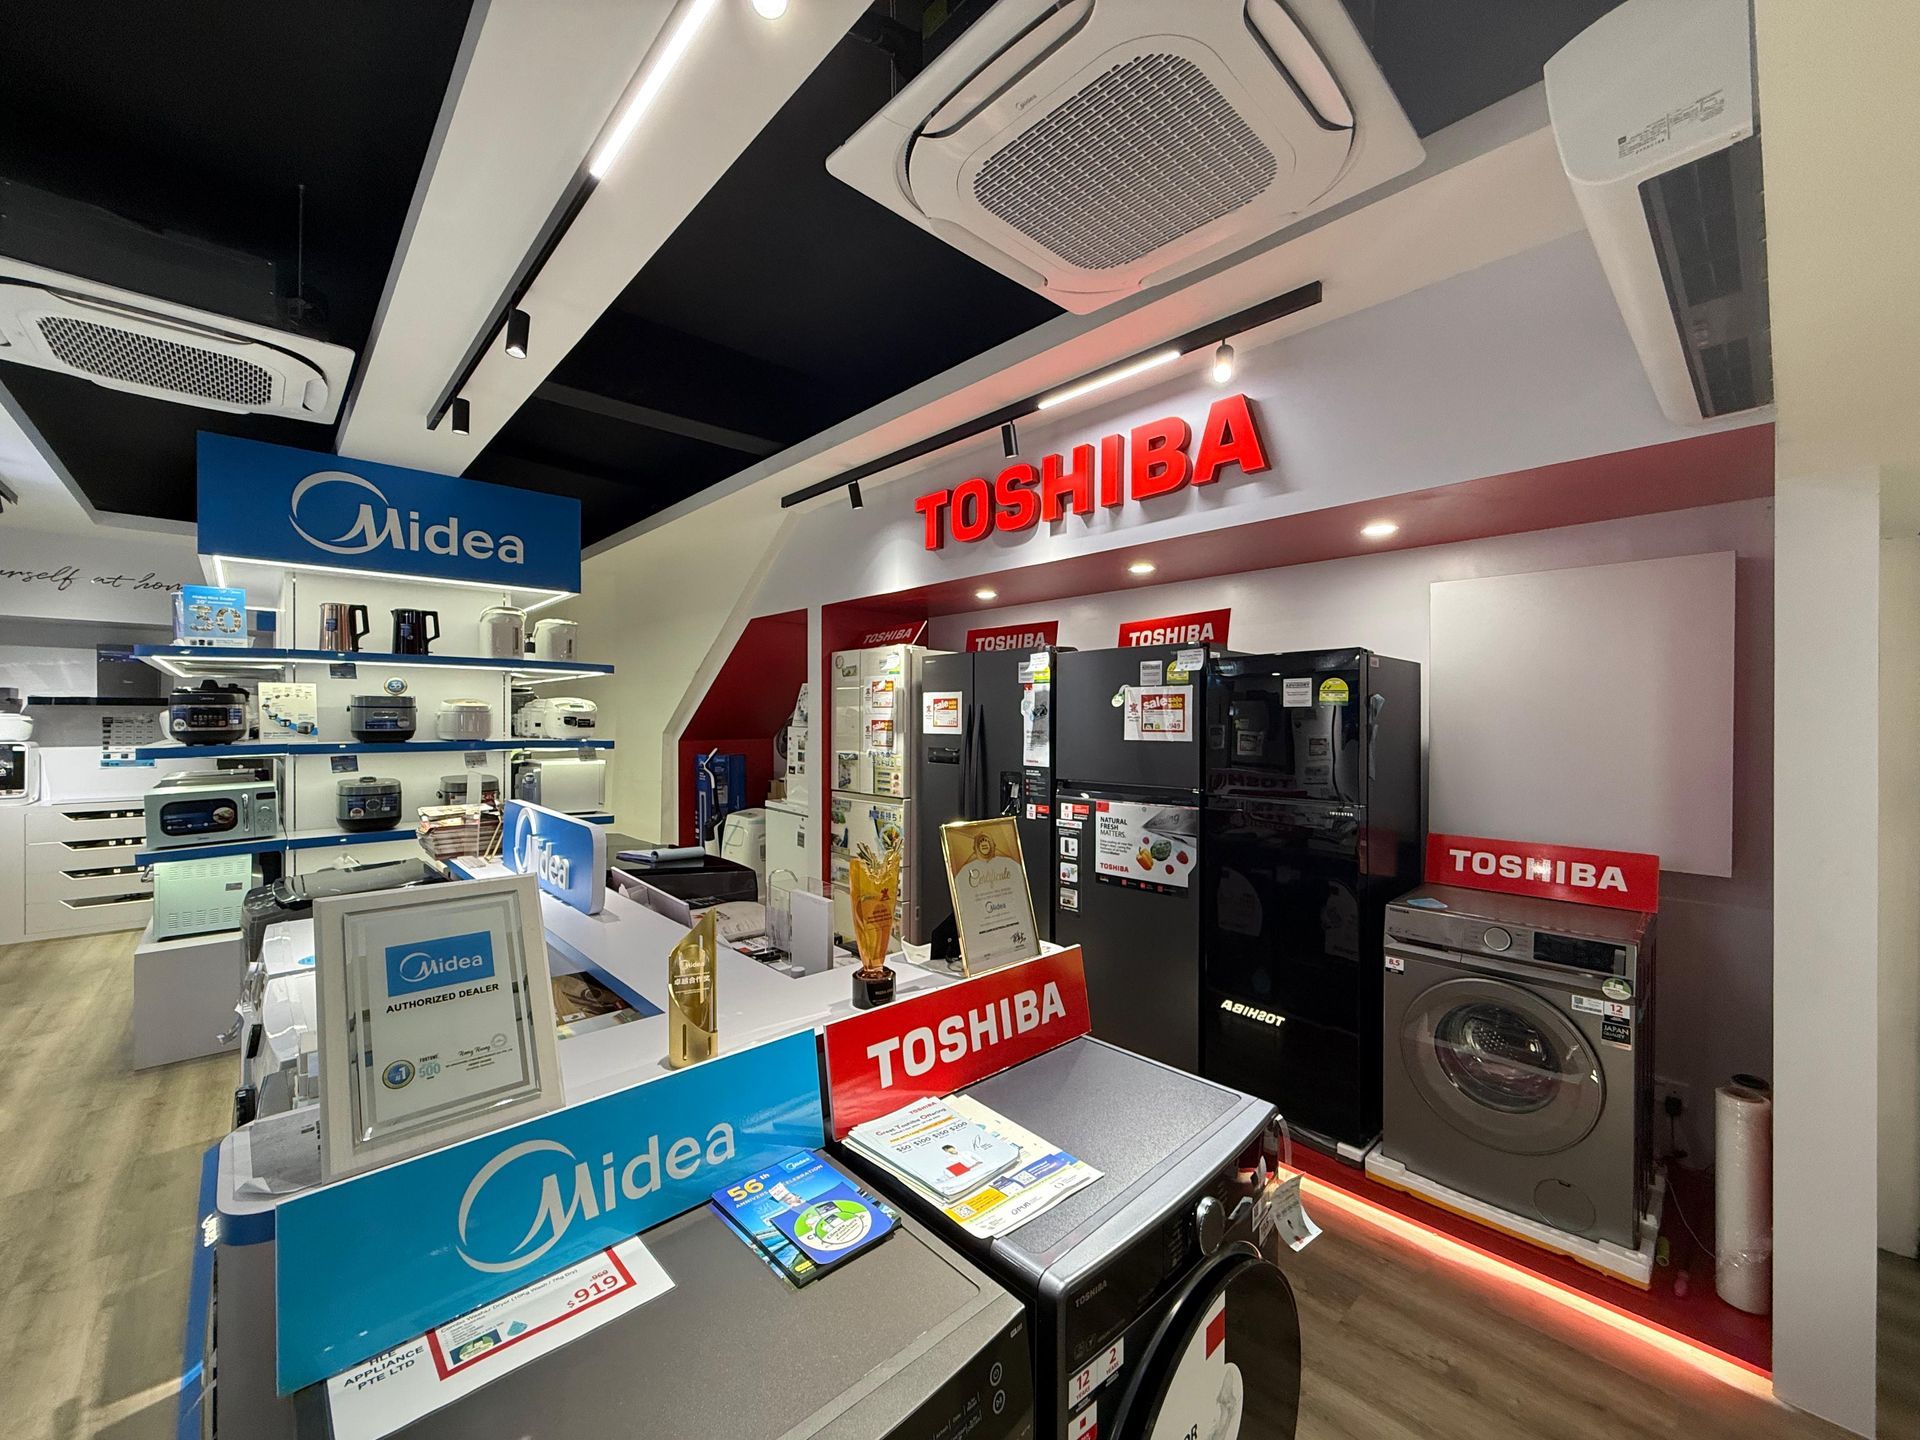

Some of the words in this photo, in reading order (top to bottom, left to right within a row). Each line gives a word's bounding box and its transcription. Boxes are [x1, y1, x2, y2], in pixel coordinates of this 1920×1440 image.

[914, 393, 1272, 552] TOSHIBA
[288, 470, 525, 565] Midea
[189, 604, 242, 634] 30
[863, 628, 912, 645] TOSHIBA
[975, 631, 1047, 651] TOSHIBA
[1128, 622, 1215, 647] TOSHIBA
[934, 699, 949, 711] sale
[1143, 696, 1168, 710] sale
[1100, 816, 1128, 826] NATURAL
[1100, 823, 1119, 831] FRESH
[513, 806, 571, 891] Midea
[1100, 862, 1129, 873] TOSHIBA
[1449, 848, 1629, 893] TOSHIBA
[984, 900, 1007, 914] Midea
[399, 952, 483, 983] Midea
[680, 959, 705, 970] Midea
[1388, 958, 1401, 967] 8.5
[385, 991, 457, 1014] AUTHORIZED
[458, 983, 500, 999] DEALER
[1610, 1003, 1624, 1014] 12
[866, 981, 1067, 1090] TOSHIBA
[1603, 1024, 1629, 1036] JAPAN
[418, 1062, 441, 1079] 500
[909, 1101, 937, 1115] TOSHIBA
[895, 1144, 912, 1153] $50
[913, 1136, 932, 1146] $100
[932, 1129, 949, 1139] $150
[949, 1121, 968, 1132] $200
[785, 1157, 811, 1170] Midea
[455, 1122, 735, 1273] Midea
[726, 1178, 765, 1202] 56
[759, 1173, 770, 1181] th
[736, 1190, 770, 1209] ANNIVERS
[1074, 1279, 1108, 1308] TOSHIBA
[1109, 1347, 1117, 1365] 2
[343, 1345, 425, 1388] APPLIANCE
[357, 1372, 386, 1391] PTE
[389, 1359, 415, 1376] LTD
[1076, 1369, 1090, 1392] 12
